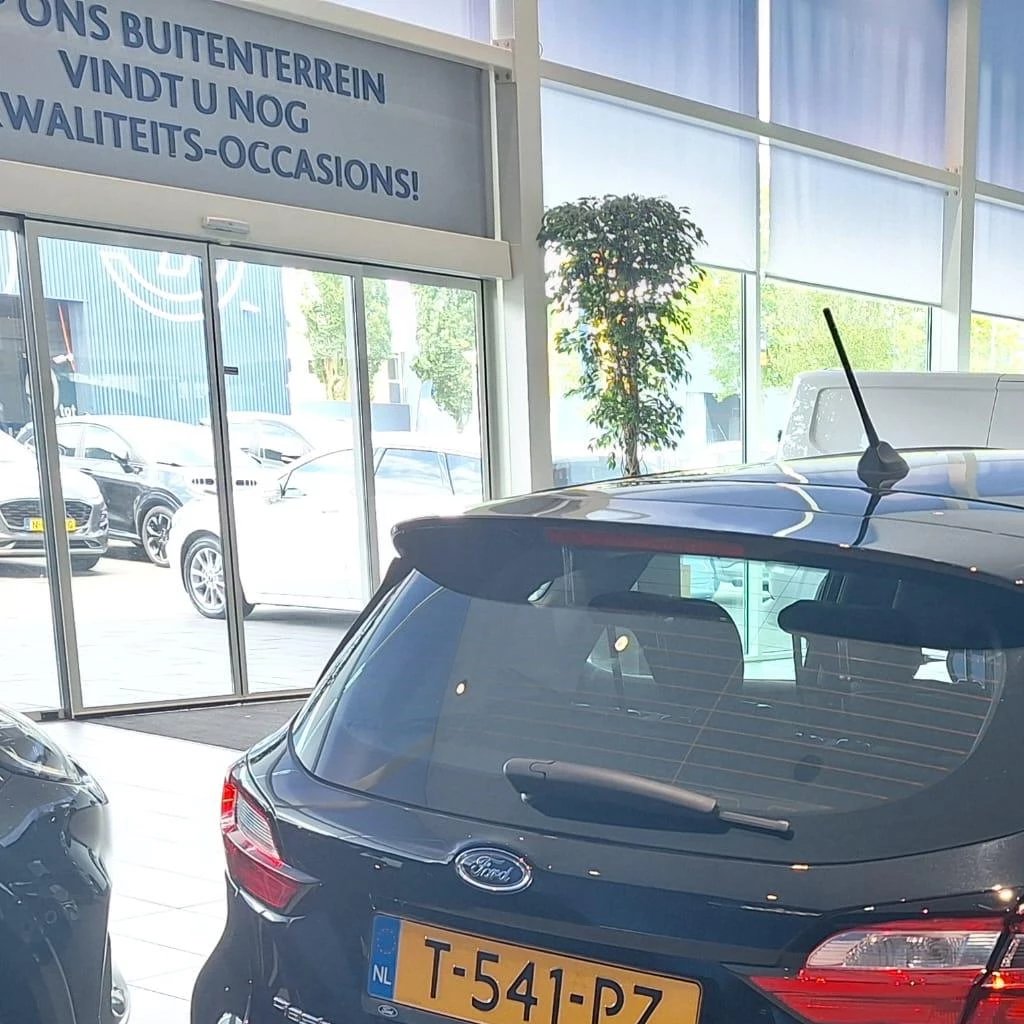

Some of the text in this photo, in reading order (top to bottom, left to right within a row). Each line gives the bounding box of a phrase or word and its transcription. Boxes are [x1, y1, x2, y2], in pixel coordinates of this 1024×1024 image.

[19, 0, 387, 105] ONS BUITENTERREIN
[58, 50, 309, 133] VINDT U NOG
[0, 91, 419, 201] WALITEITS-OCCASIONS!
[470, 855, 514, 882] Ford
[373, 964, 392, 985] NL
